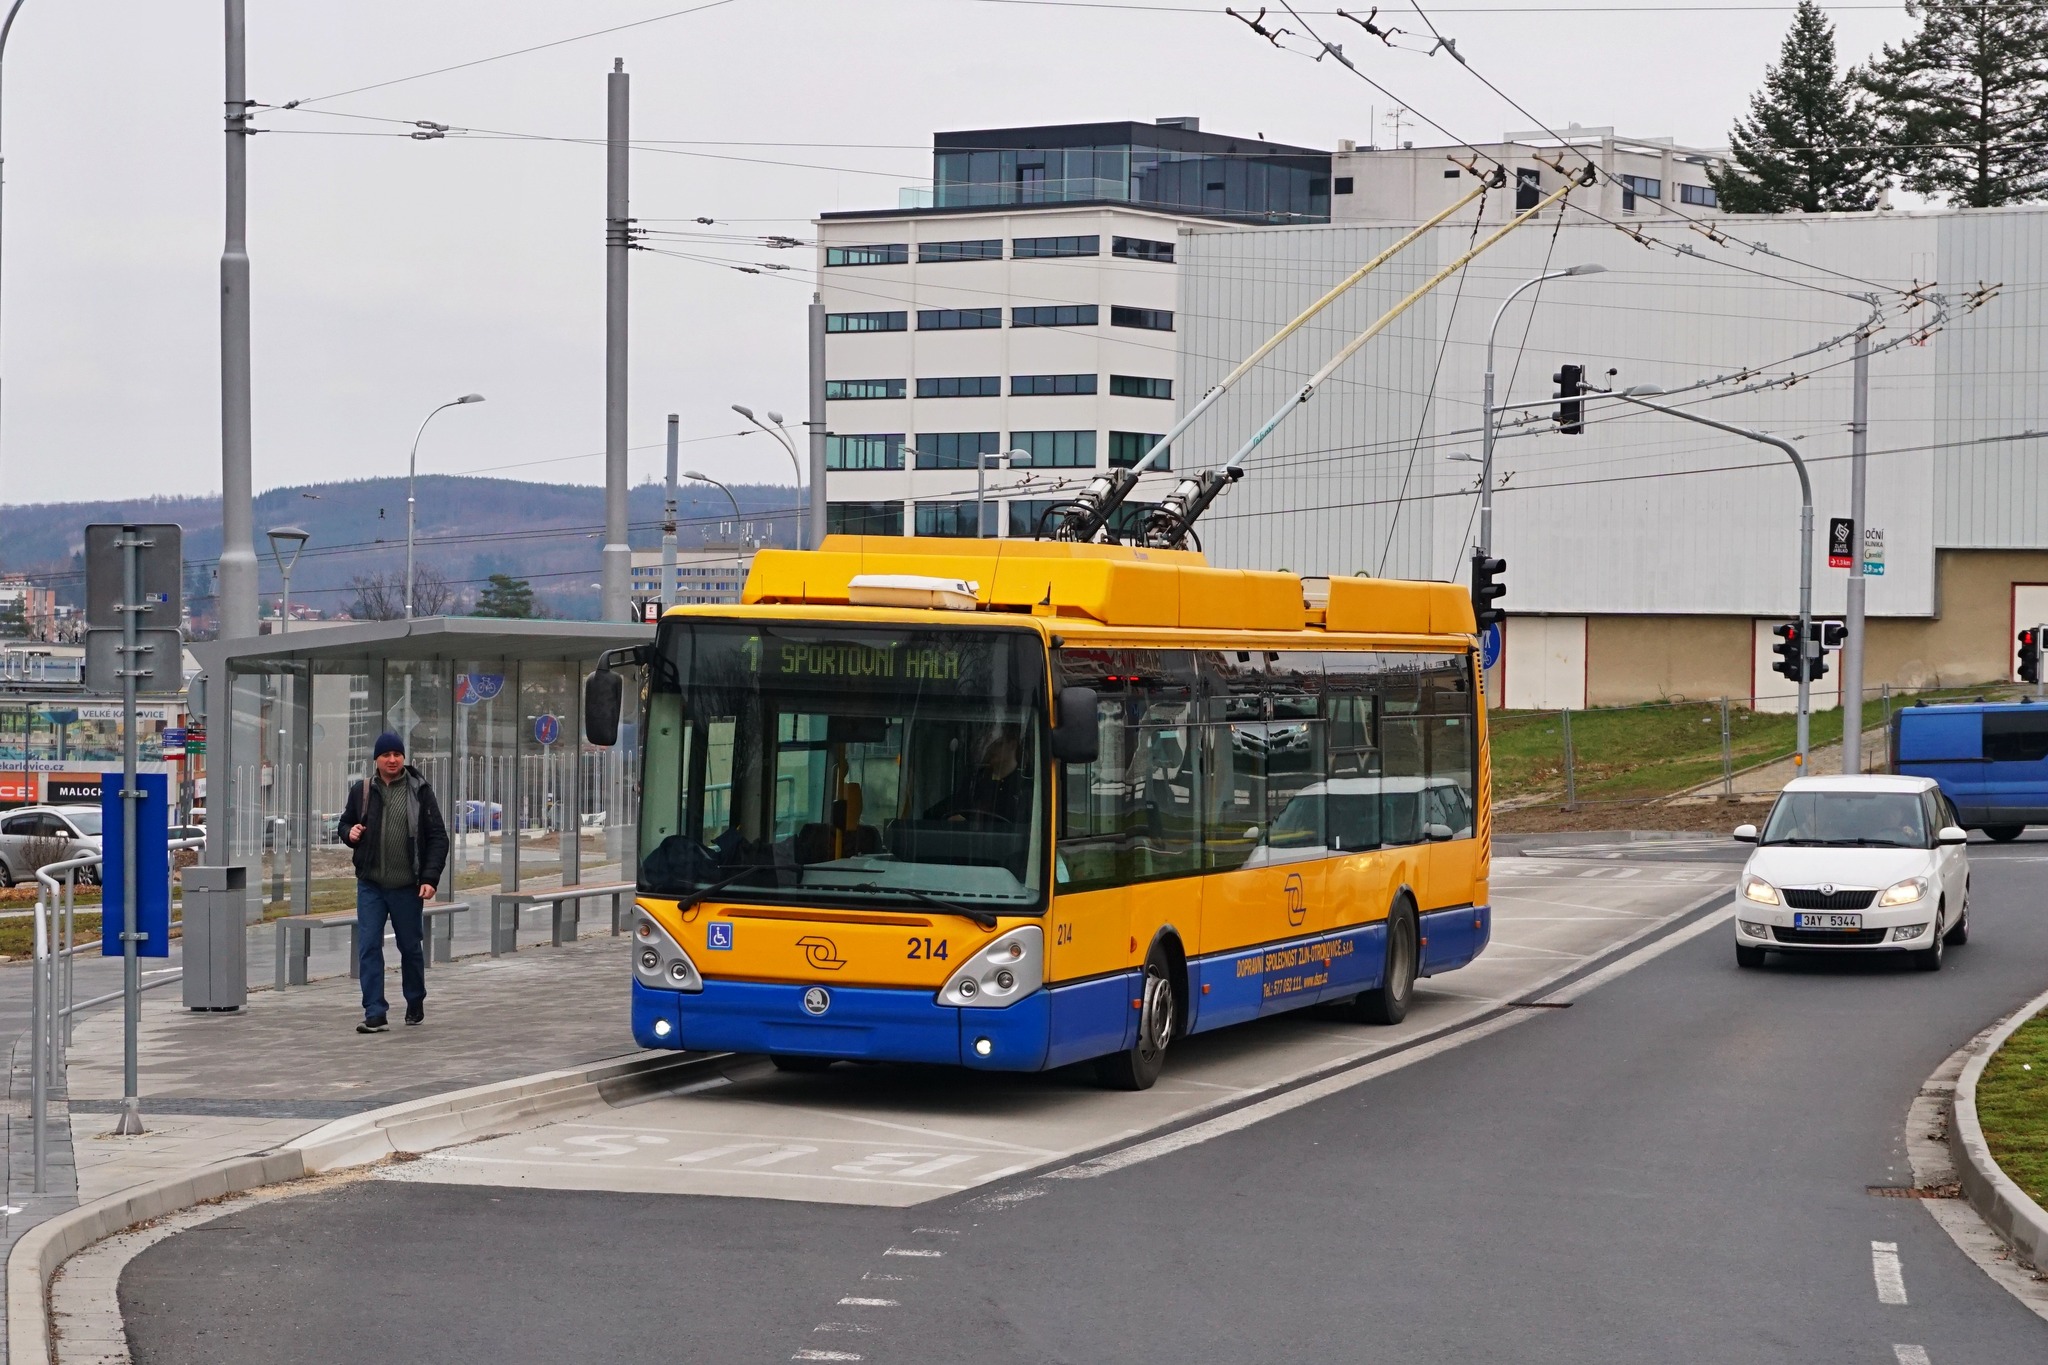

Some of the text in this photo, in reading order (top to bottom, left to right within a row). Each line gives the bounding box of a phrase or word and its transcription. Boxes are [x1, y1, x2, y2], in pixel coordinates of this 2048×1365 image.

[1865, 528, 1884, 540] OČNÍ
[741, 636, 959, 679] 1 SPORTOVNÍ HALA
[82, 709, 111, 718] VELKÉ
[1804, 915, 1822, 926] 3AY
[1830, 915, 1856, 926] 5344
[1057, 923, 1072, 946] 214
[907, 937, 948, 960] 214
[524, 1133, 980, 1178] BUS
